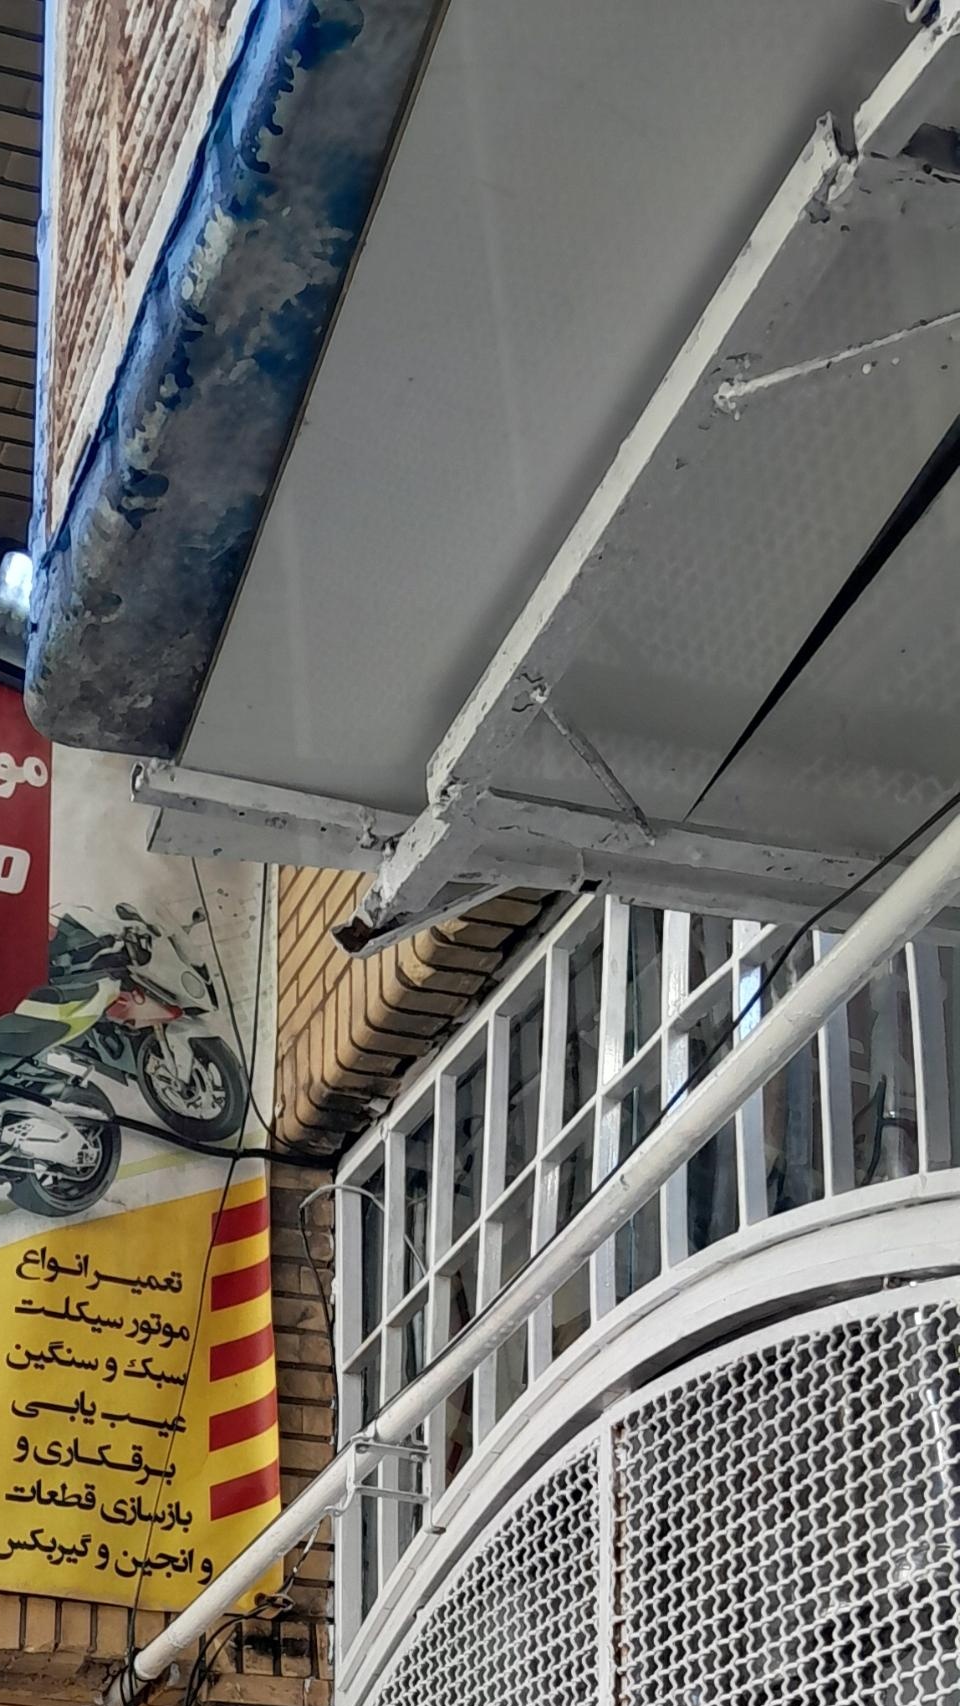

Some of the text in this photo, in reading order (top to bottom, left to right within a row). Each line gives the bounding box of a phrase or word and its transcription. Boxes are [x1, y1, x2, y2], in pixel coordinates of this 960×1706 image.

[14, 1246, 183, 1294] تعمیر انواع
[14, 1296, 190, 1347] موتور سیکلت
[5, 1340, 187, 1389] سبک و سنگین
[11, 1391, 187, 1438] عیب یابی
[13, 1432, 29, 1462] و
[4, 1479, 193, 1533] بازسازی قطعات
[95, 1542, 110, 1571] و
[114, 1548, 193, 1578] انجین
[197, 1556, 214, 1584] و
